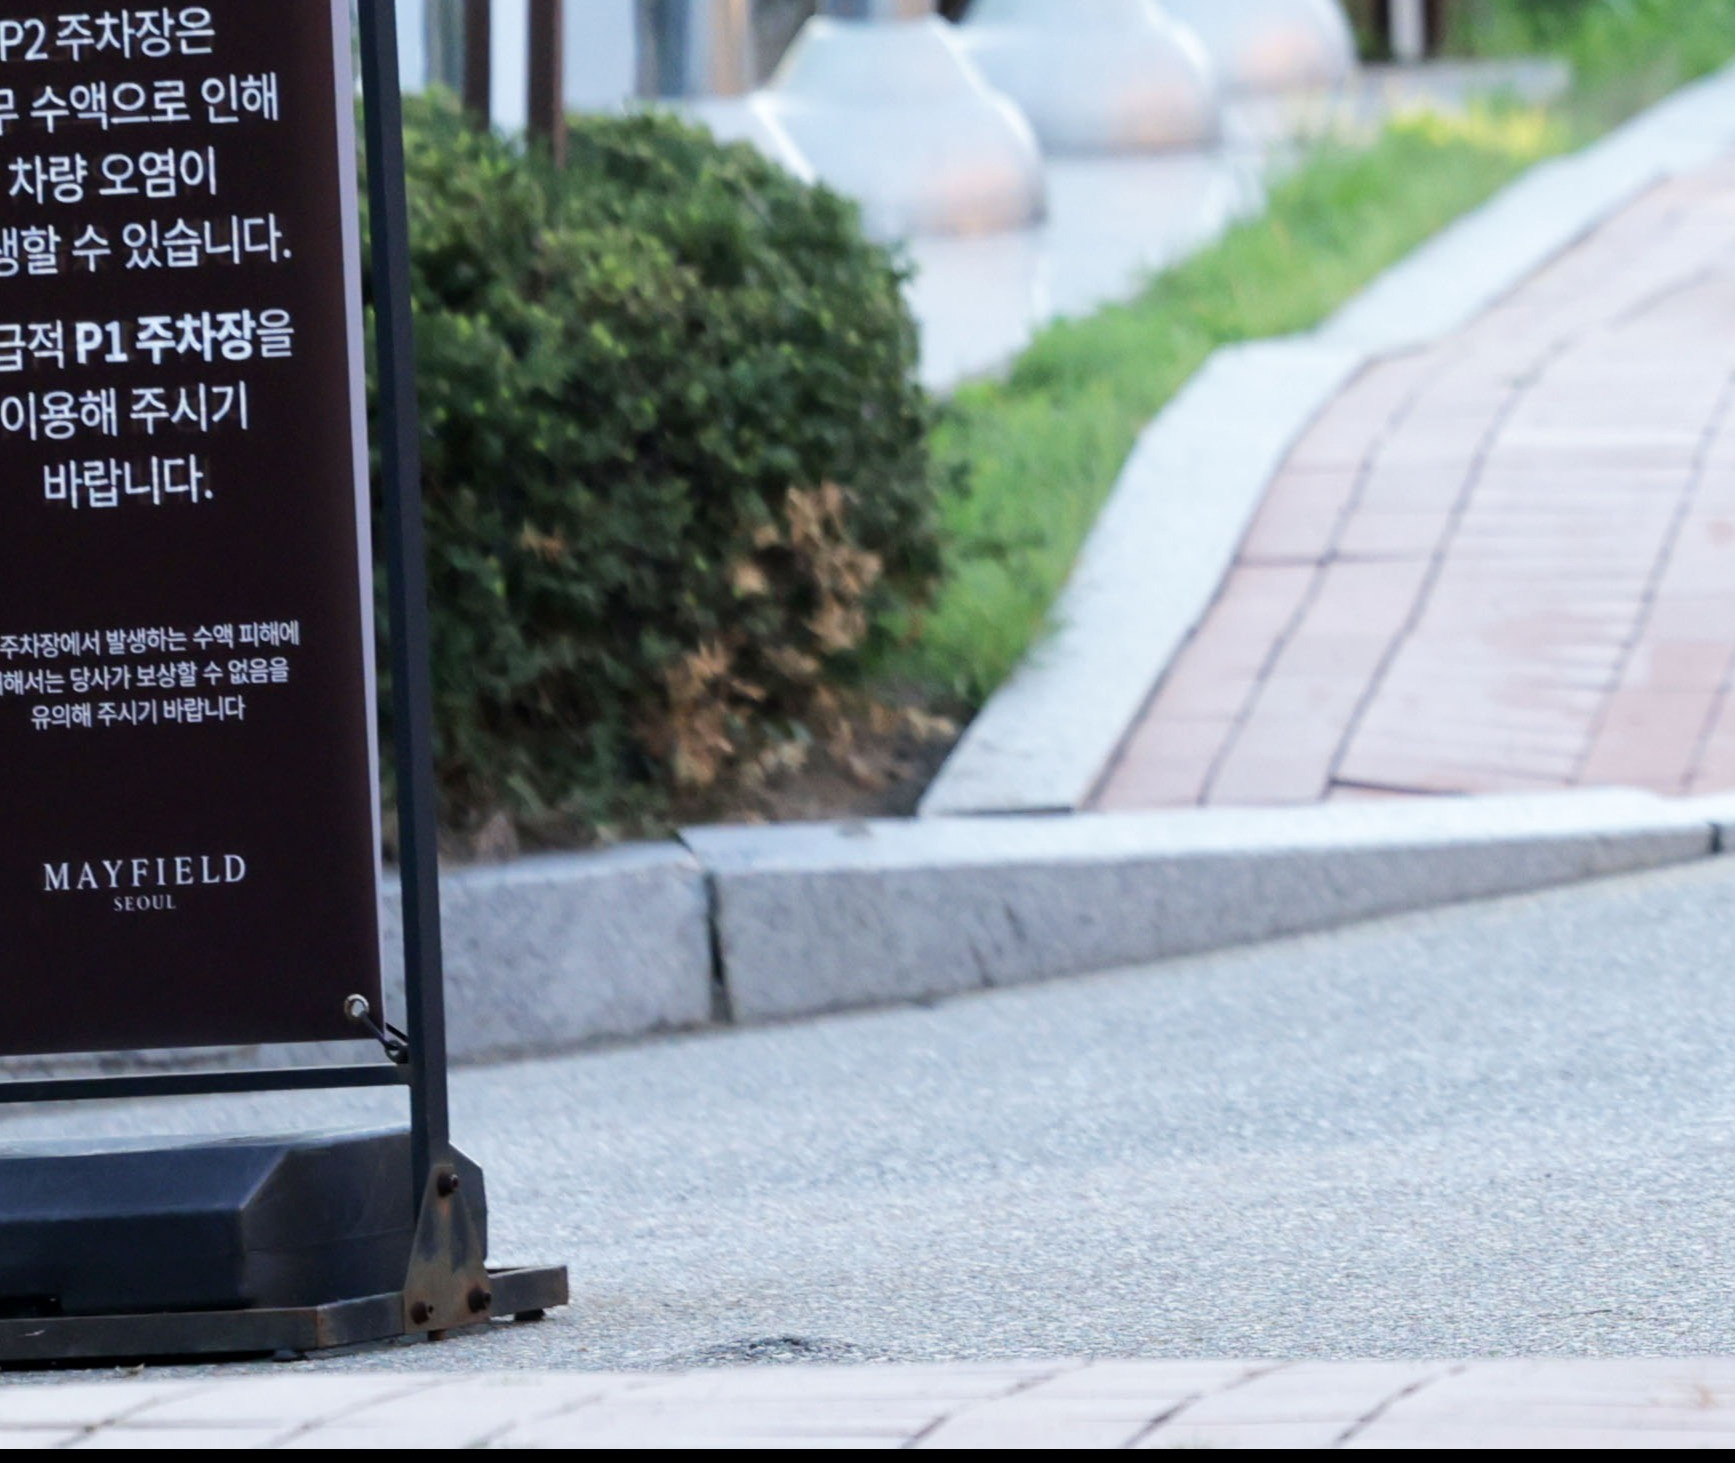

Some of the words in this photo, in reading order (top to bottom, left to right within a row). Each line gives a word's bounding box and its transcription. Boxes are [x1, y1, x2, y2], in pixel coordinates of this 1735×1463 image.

[0, 18, 48, 61] P2
[56, 6, 215, 61] 주차장은
[30, 80, 191, 133] 수액으로
[201, 71, 279, 124] 인해
[8, 152, 88, 204] 차량
[99, 145, 216, 197] 오염이
[72, 224, 111, 272] 수
[122, 212, 292, 269] 있습니다.
[75, 320, 129, 364] P1
[135, 308, 294, 365] 주차장을
[0, 387, 118, 441] 이용해
[130, 380, 248, 435] 주시기
[43, 453, 214, 509] 바랍니다.
[0, 630, 101, 660] 주차장에서
[105, 626, 187, 655] 발생하는
[193, 622, 234, 650] 수액
[239, 619, 300, 648] 피해에
[70, 664, 132, 693] 당사가
[136, 661, 198, 688] 보상할
[203, 661, 223, 686] 수
[227, 657, 290, 685] 없음을
[30, 702, 92, 731] 유의해
[97, 698, 158, 726] 주시기
[162, 694, 247, 723] 바랍니다
[43, 853, 247, 891] MAYFIELD
[113, 894, 177, 912] SEOUL
